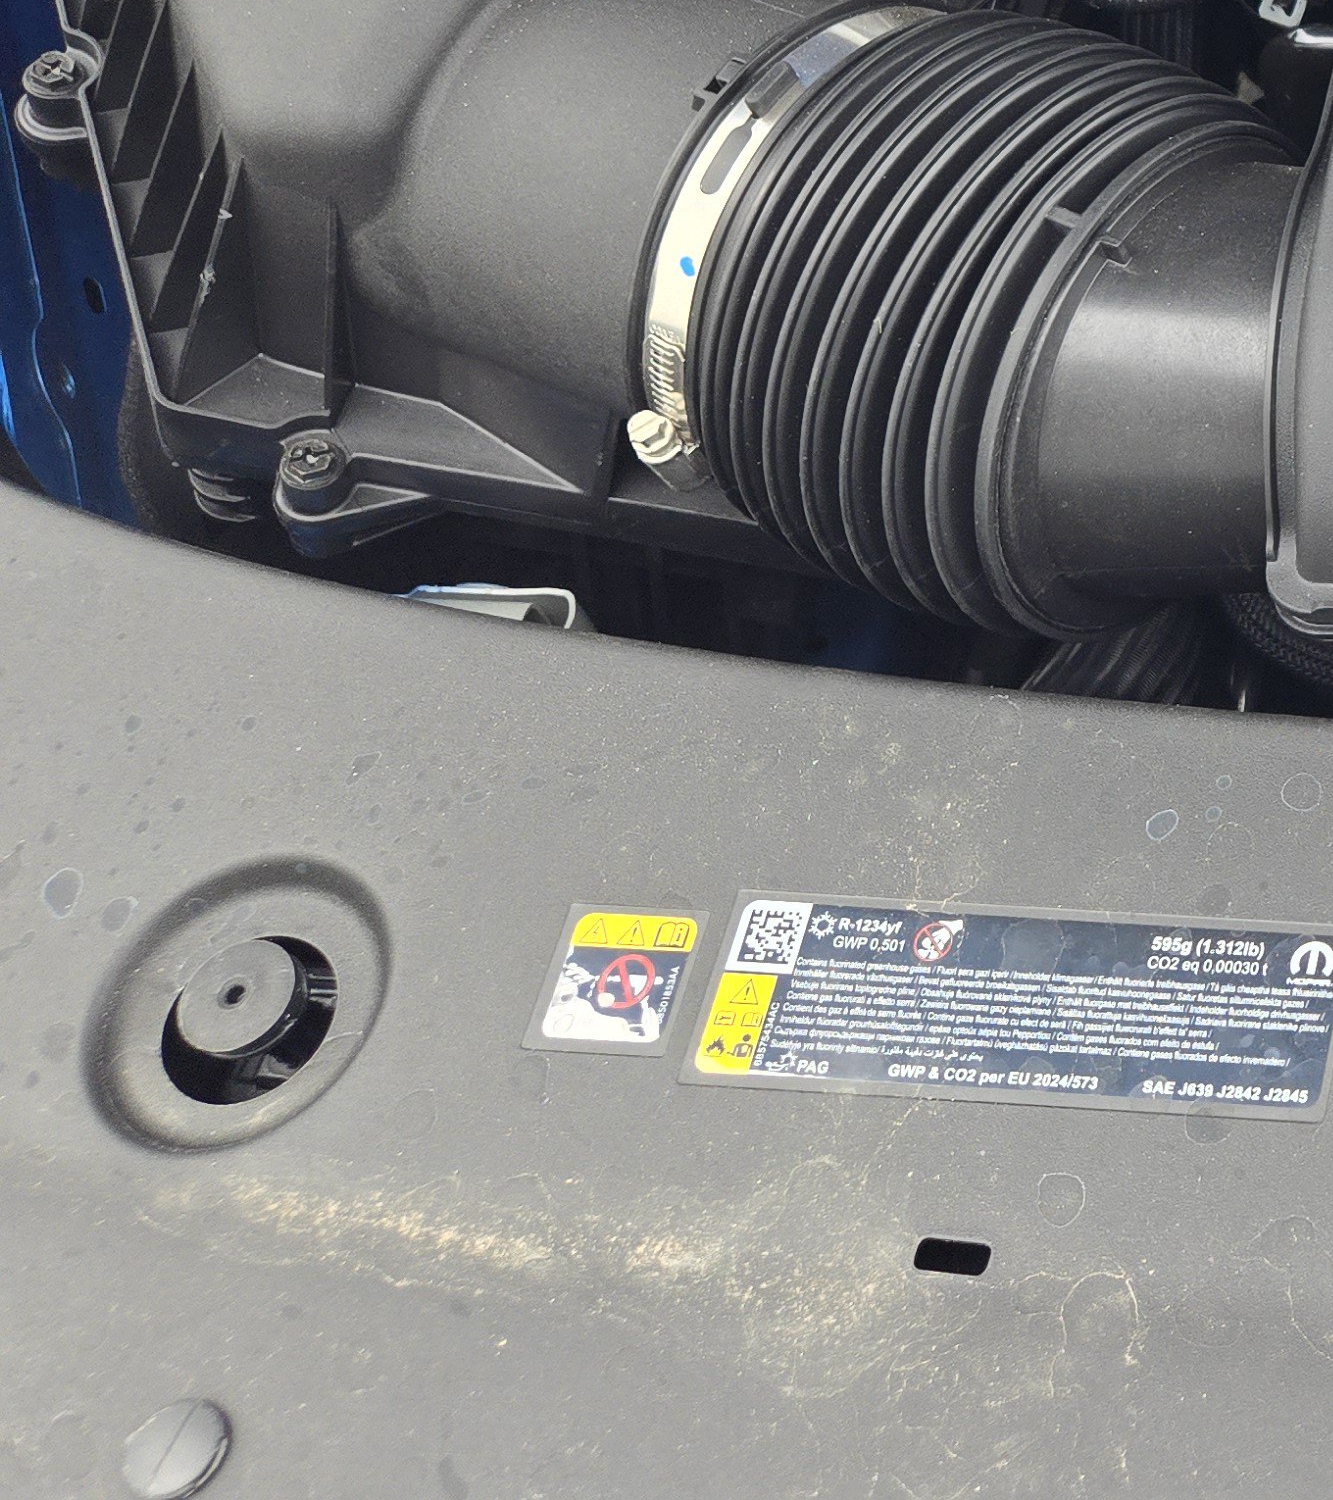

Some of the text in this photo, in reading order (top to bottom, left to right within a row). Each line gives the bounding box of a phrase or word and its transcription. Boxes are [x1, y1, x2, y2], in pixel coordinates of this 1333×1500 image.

[838, 917, 903, 935] R-1234yf
[833, 934, 906, 953] GWP 0,501
[1150, 935, 1266, 959] 595g (1.312lb)
[1147, 957, 1178, 972] CO2
[1181, 961, 1199, 975] eq
[1202, 958, 1260, 976] 0,00030
[796, 1060, 830, 1075] PAG
[887, 1063, 1099, 1091] GWP & CO2 per EU 2024/573
[1142, 1079, 1309, 1105] SAE J639 J2842 J2845
